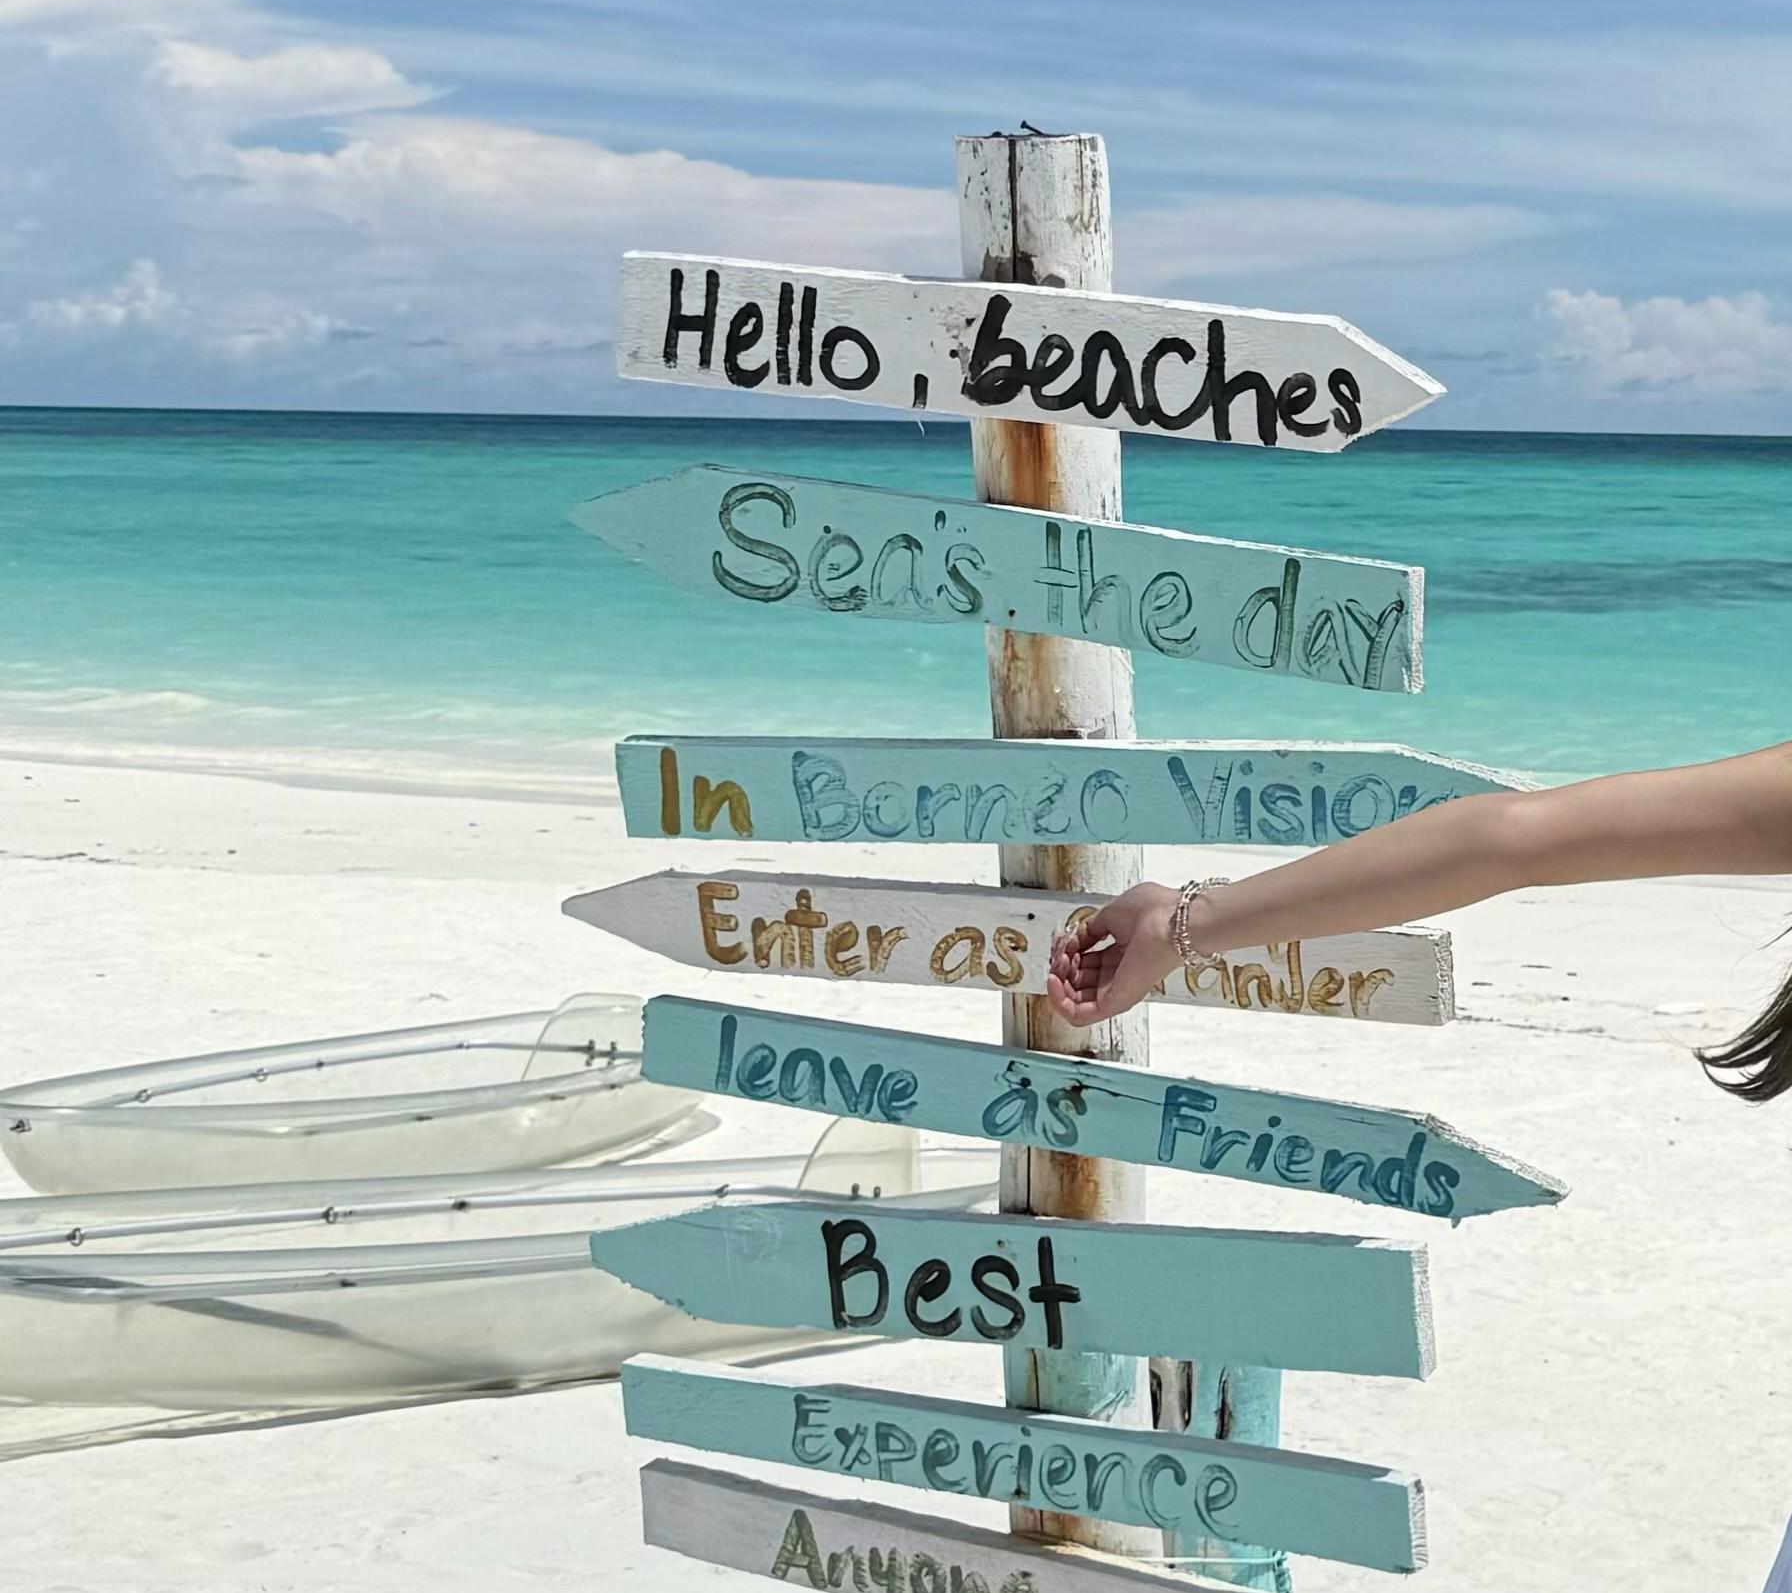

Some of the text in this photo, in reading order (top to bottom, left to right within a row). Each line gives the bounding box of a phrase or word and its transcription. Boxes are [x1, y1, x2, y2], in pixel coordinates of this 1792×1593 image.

[960, 293, 1363, 447] beaches
[711, 481, 1406, 690] Sea's the day
[659, 747, 753, 839] In
[791, 750, 1130, 843] Borneo
[696, 881, 907, 977] Enter
[929, 923, 1030, 987] as
[714, 1013, 1459, 1216] leave as Friends
[820, 1217, 1081, 1350] Best
[790, 1393, 1240, 1541] Experience
